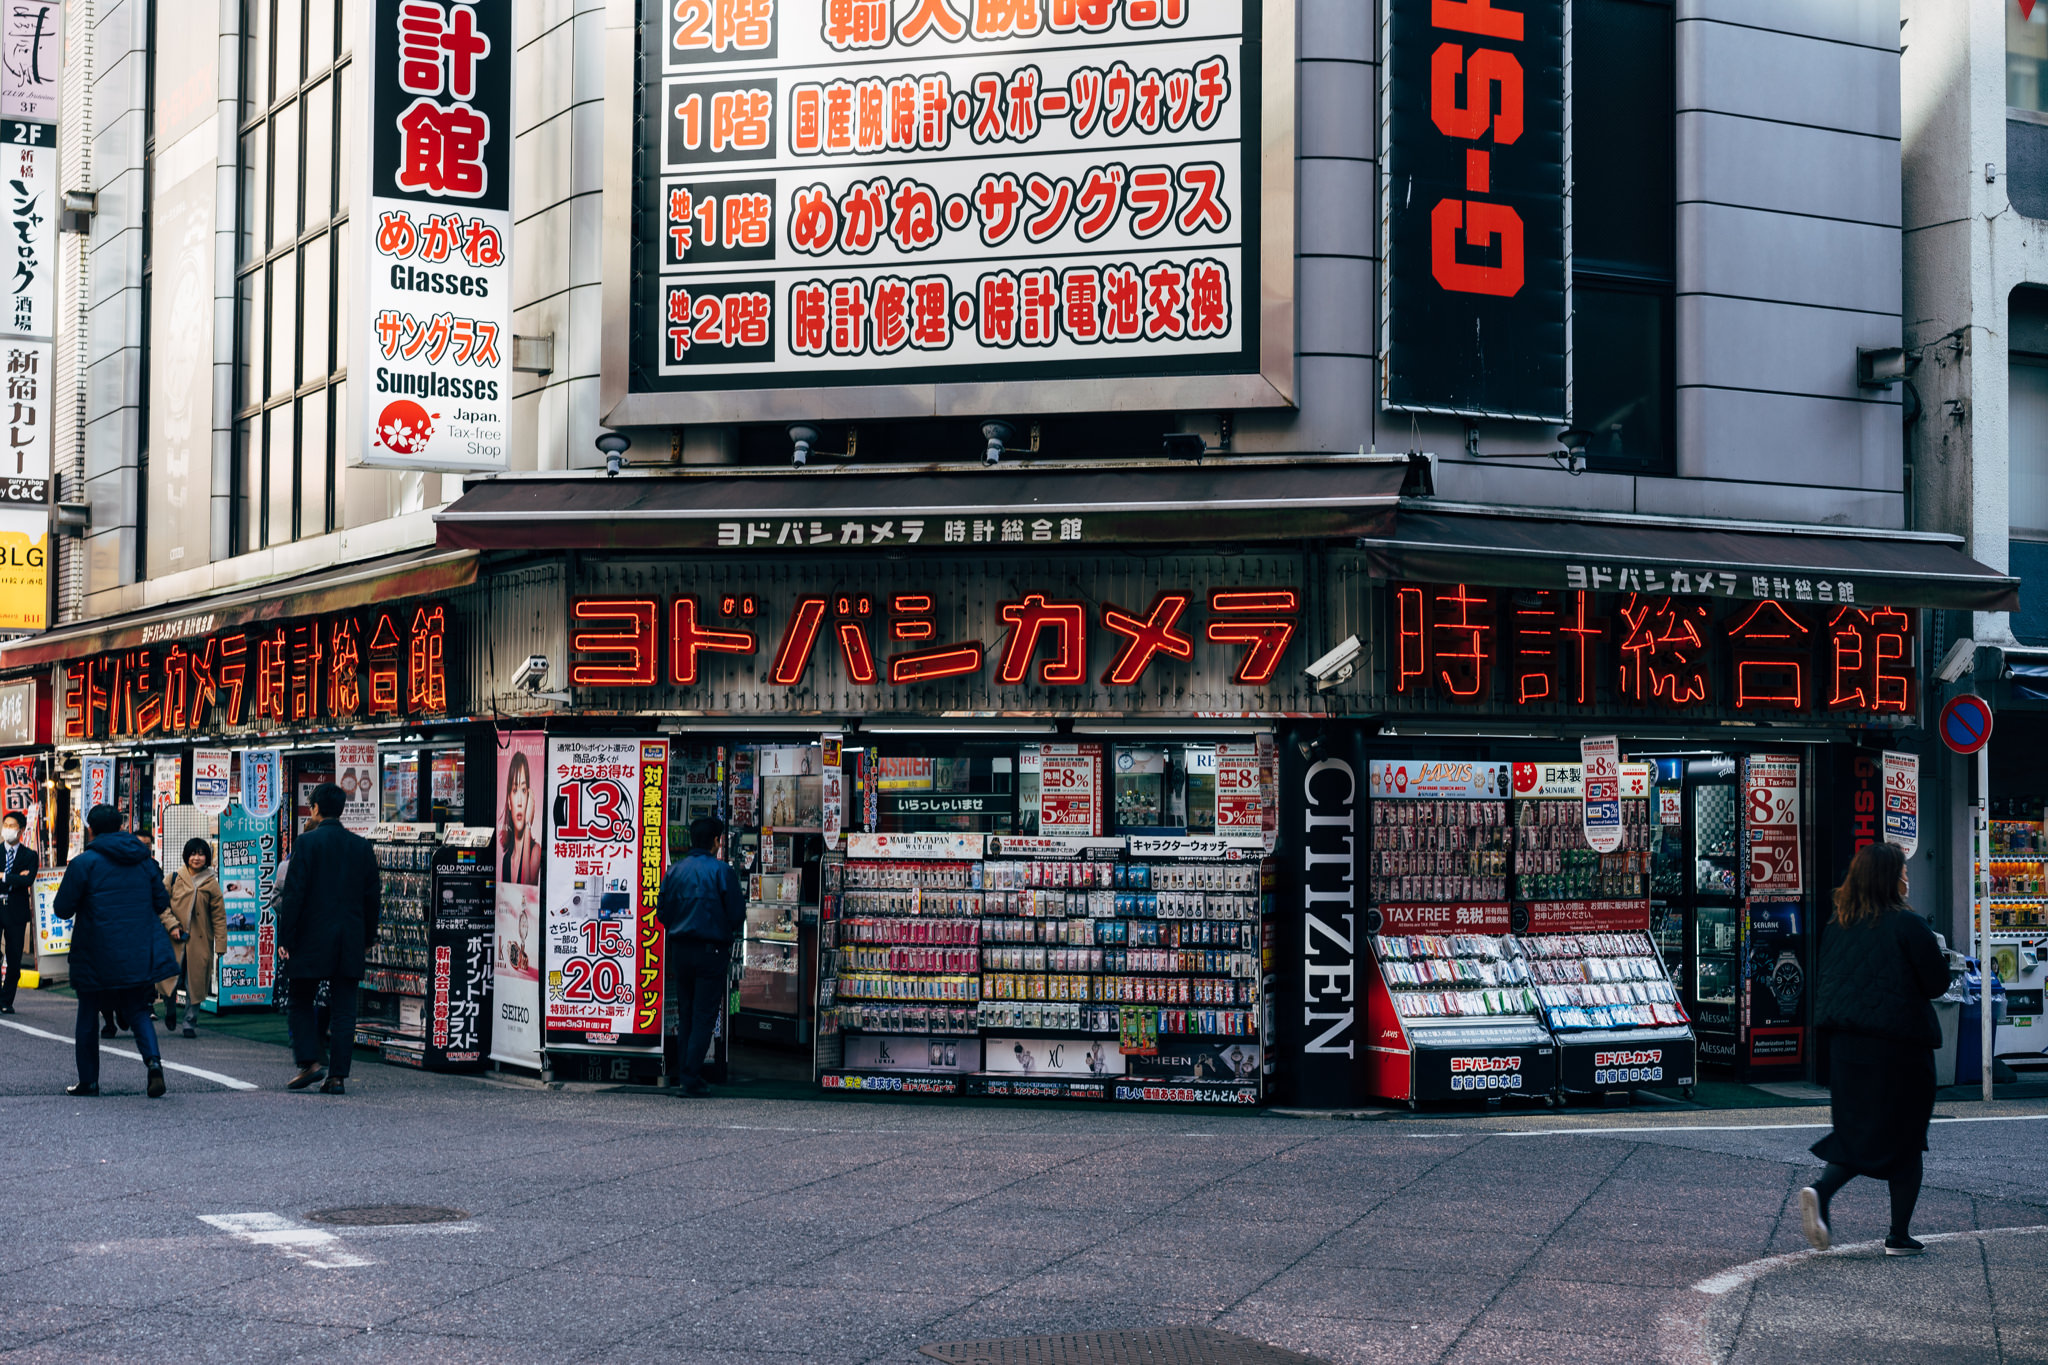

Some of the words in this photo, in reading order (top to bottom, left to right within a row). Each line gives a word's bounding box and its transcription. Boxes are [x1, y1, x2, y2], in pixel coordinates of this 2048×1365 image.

[674, 0, 772, 52] 2階
[20, 101, 37, 113] 3F
[395, 0, 491, 199] 計館
[674, 92, 770, 152] 1階
[792, 56, 1229, 155] 国産腕時計・スポーツウォッチ
[13, 124, 42, 145] 2F
[20, 149, 34, 179] 新橋
[669, 189, 692, 260] 地下
[697, 195, 769, 247] 1階
[795, 163, 1226, 253] めがね・サングラス
[376, 210, 506, 268] めがね
[390, 264, 489, 298] Glasses
[14, 296, 33, 332] 酒場
[668, 292, 692, 361] 地下
[693, 295, 768, 347] 2階
[794, 260, 1228, 354] 時計修理・時計電池交換
[374, 309, 500, 368] サングラス
[376, 366, 499, 401] Sunglasses
[7, 348, 39, 474] 新宿カレー
[452, 406, 501, 424] Japan.
[446, 424, 502, 442] Tax-free
[466, 441, 502, 459] Shop
[9, 478, 26, 487] curry
[28, 479, 44, 487] shop
[8, 484, 43, 500] C&C
[717, 521, 924, 547] ヨドバシカメラ
[943, 519, 1083, 545] 時計総合館
[1566, 564, 1737, 597] ヨドバシカメラ
[1752, 575, 1856, 604] 時計総合館
[570, 592, 1299, 688] ヨドバシカメラ
[1396, 584, 1912, 712] 時計総合館
[339, 745, 375, 754] 欢迎光临
[557, 742, 635, 753] 通常10%ポイント還元の
[339, 755, 374, 764] 友都八喜
[572, 753, 619, 763] 商品の多くが
[1596, 756, 1616, 776] 8%
[206, 763, 228, 778] 8%
[557, 764, 634, 778] 今ならお得な
[1062, 768, 1089, 788] 8%
[1546, 768, 1581, 783] 日本製
[1768, 778, 1794, 787] Tax-Free
[1895, 771, 1916, 792] 8%
[557, 780, 633, 839] 13%
[898, 799, 983, 810] いらっしゃいませ
[1042, 801, 1069, 823] 5%
[1218, 802, 1246, 825] 5%
[1661, 799, 1679, 812] 13%
[1749, 788, 1794, 824] 8%
[238, 817, 275, 832] fitbit
[222, 841, 256, 850] 身に付けて
[890, 836, 910, 844] MADE
[924, 836, 949, 844] JAPAN
[1133, 840, 1227, 851] キャラクターウォッチ
[555, 843, 633, 859] 特別ポイント
[437, 864, 455, 872] GOLD
[456, 864, 475, 872] POINT
[574, 860, 611, 876] 還元!
[1751, 846, 1794, 883] 5%
[640, 764, 663, 1029] 対象商品特別ポイントアップ
[1304, 757, 1356, 1060] CITIZEN
[1387, 907, 1414, 922] TAX
[1417, 907, 1450, 921] FREE
[1456, 907, 1483, 925] 免税
[549, 921, 577, 934] さらに
[553, 936, 578, 944] 一部の
[582, 921, 634, 956] 15%
[553, 945, 577, 954] 商品は
[222, 968, 246, 977] 試せて
[564, 960, 634, 1002] 20%
[466, 936, 481, 1049] ポイントカード
[549, 970, 563, 1000] 最大
[433, 946, 451, 1049] 新規会員募集中
[501, 1003, 529, 1024] SEIKO
[550, 1005, 631, 1017] 特別ポイント還元!
[1141, 1056, 1192, 1066] SHEEN
[1451, 1056, 1521, 1072] ヨドバシカメラ
[1594, 1050, 1662, 1066] ヨドバシカメラ
[1451, 1074, 1522, 1090] 新宿西口本店
[1595, 1067, 1663, 1084] 新宿西口本店
